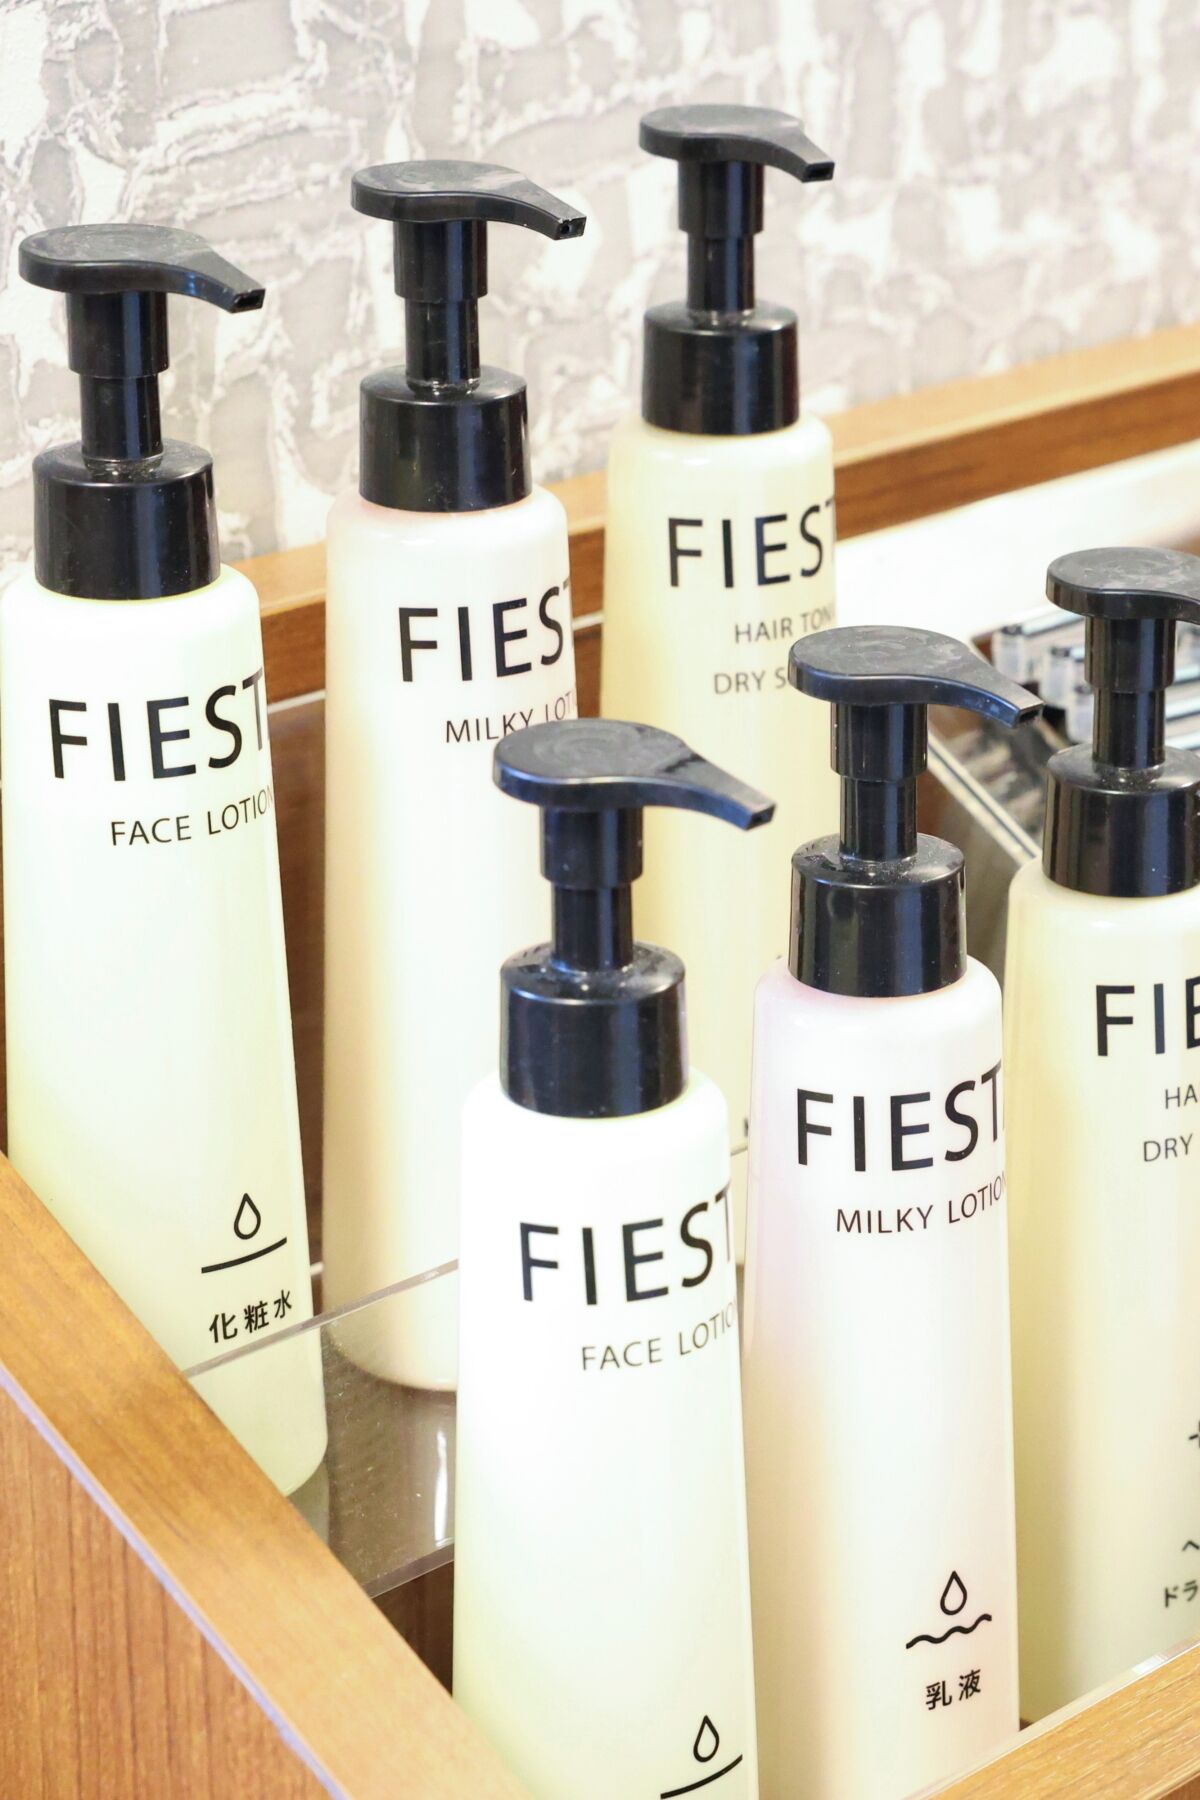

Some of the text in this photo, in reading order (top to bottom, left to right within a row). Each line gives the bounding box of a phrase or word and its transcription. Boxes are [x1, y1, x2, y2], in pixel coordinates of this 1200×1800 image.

[735, 617, 793, 644] HAIR
[714, 670, 765, 694] DRY
[49, 667, 264, 781] FIEST
[111, 815, 192, 846] FACE
[797, 1058, 1002, 1172] FIEST
[1143, 1133, 1193, 1162] DRY
[837, 1205, 933, 1234] MILKY
[520, 1179, 731, 1306] FIEST
[209, 1289, 292, 1344] 化粧水
[582, 1338, 662, 1371] FACE
[926, 1668, 981, 1711] 乳液
